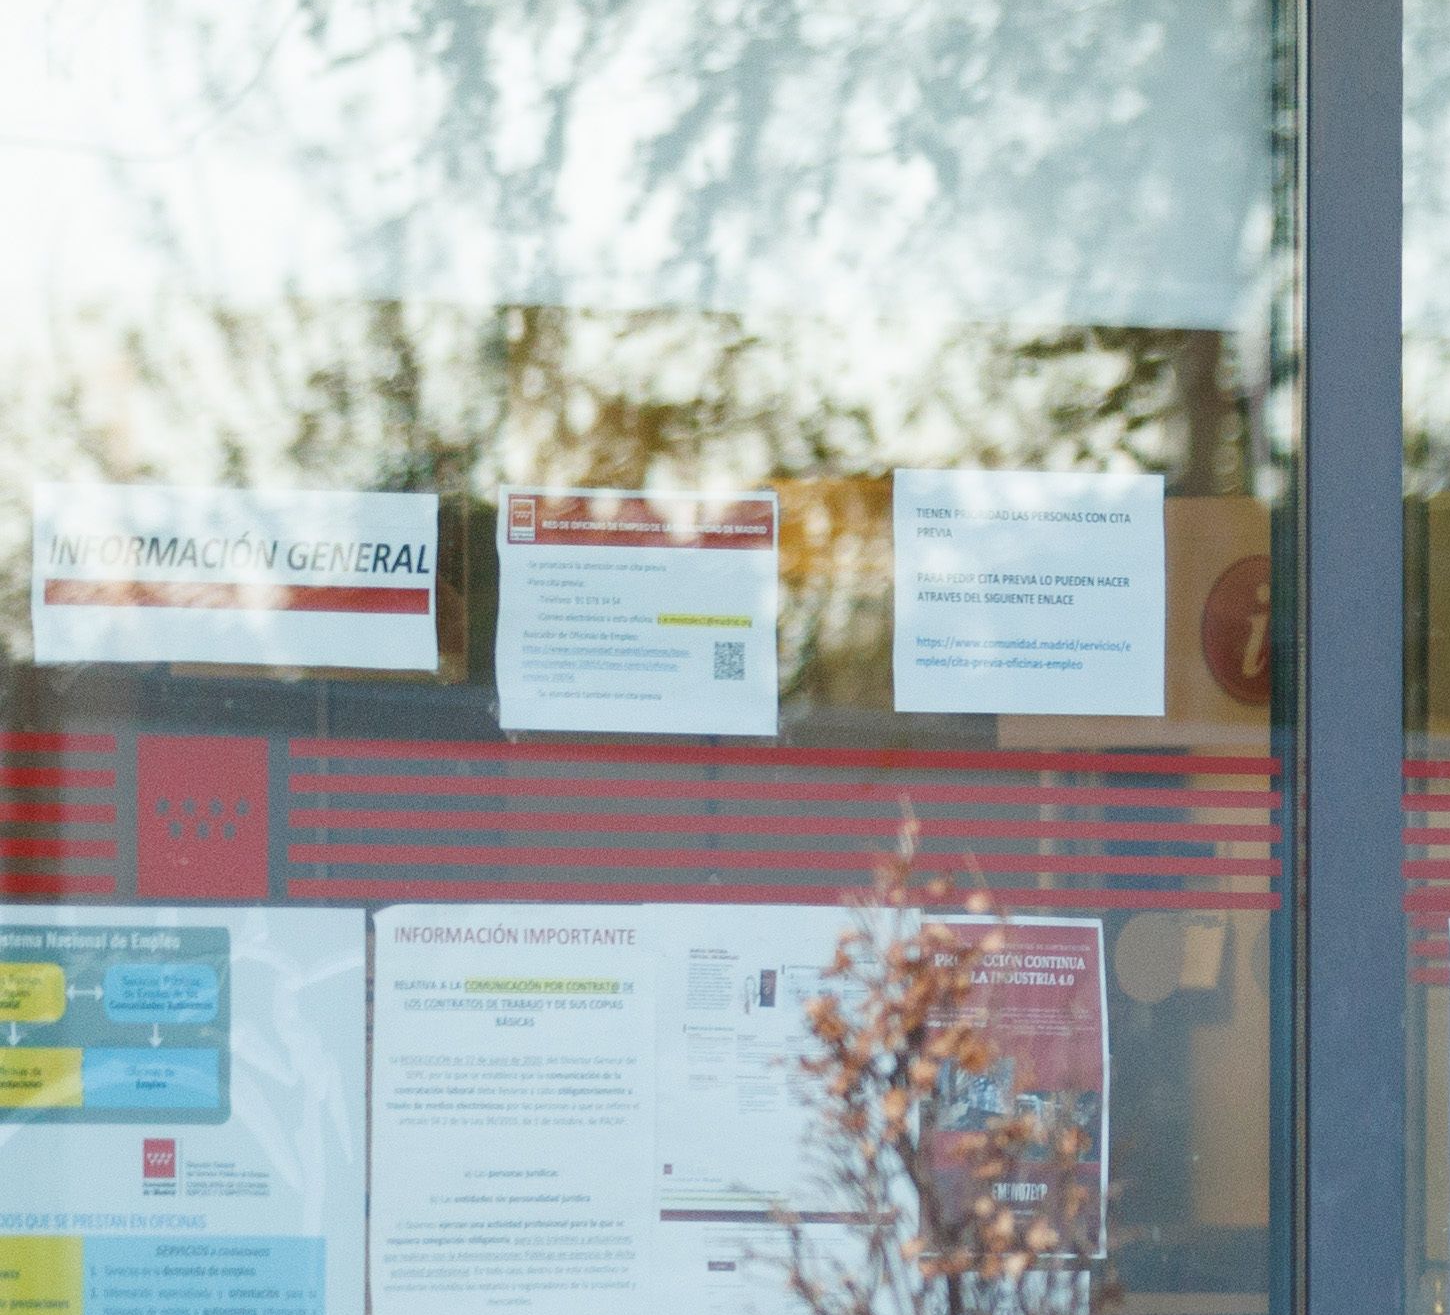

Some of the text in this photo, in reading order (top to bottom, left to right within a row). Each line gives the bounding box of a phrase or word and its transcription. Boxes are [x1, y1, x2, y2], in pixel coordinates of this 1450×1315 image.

[917, 508, 952, 518] TIENEN
[1032, 511, 1083, 522] PERSONAS
[1085, 512, 1106, 523] CON
[1110, 513, 1131, 524] CITA
[49, 531, 431, 575] INFORMACIÓN GENERAL
[978, 574, 1000, 585] CITA
[1002, 574, 1037, 585] PREVIA
[1039, 575, 1052, 586] LO
[1055, 575, 1094, 587] PUEDEN
[1097, 576, 1130, 587] HACER
[917, 592, 1074, 605] ATRAVES DEL SIGUIENTE ENLACE
[394, 924, 636, 945] INFORMACIÓN IMPORTANTE
[1024, 956, 1085, 970] CONTINUA
